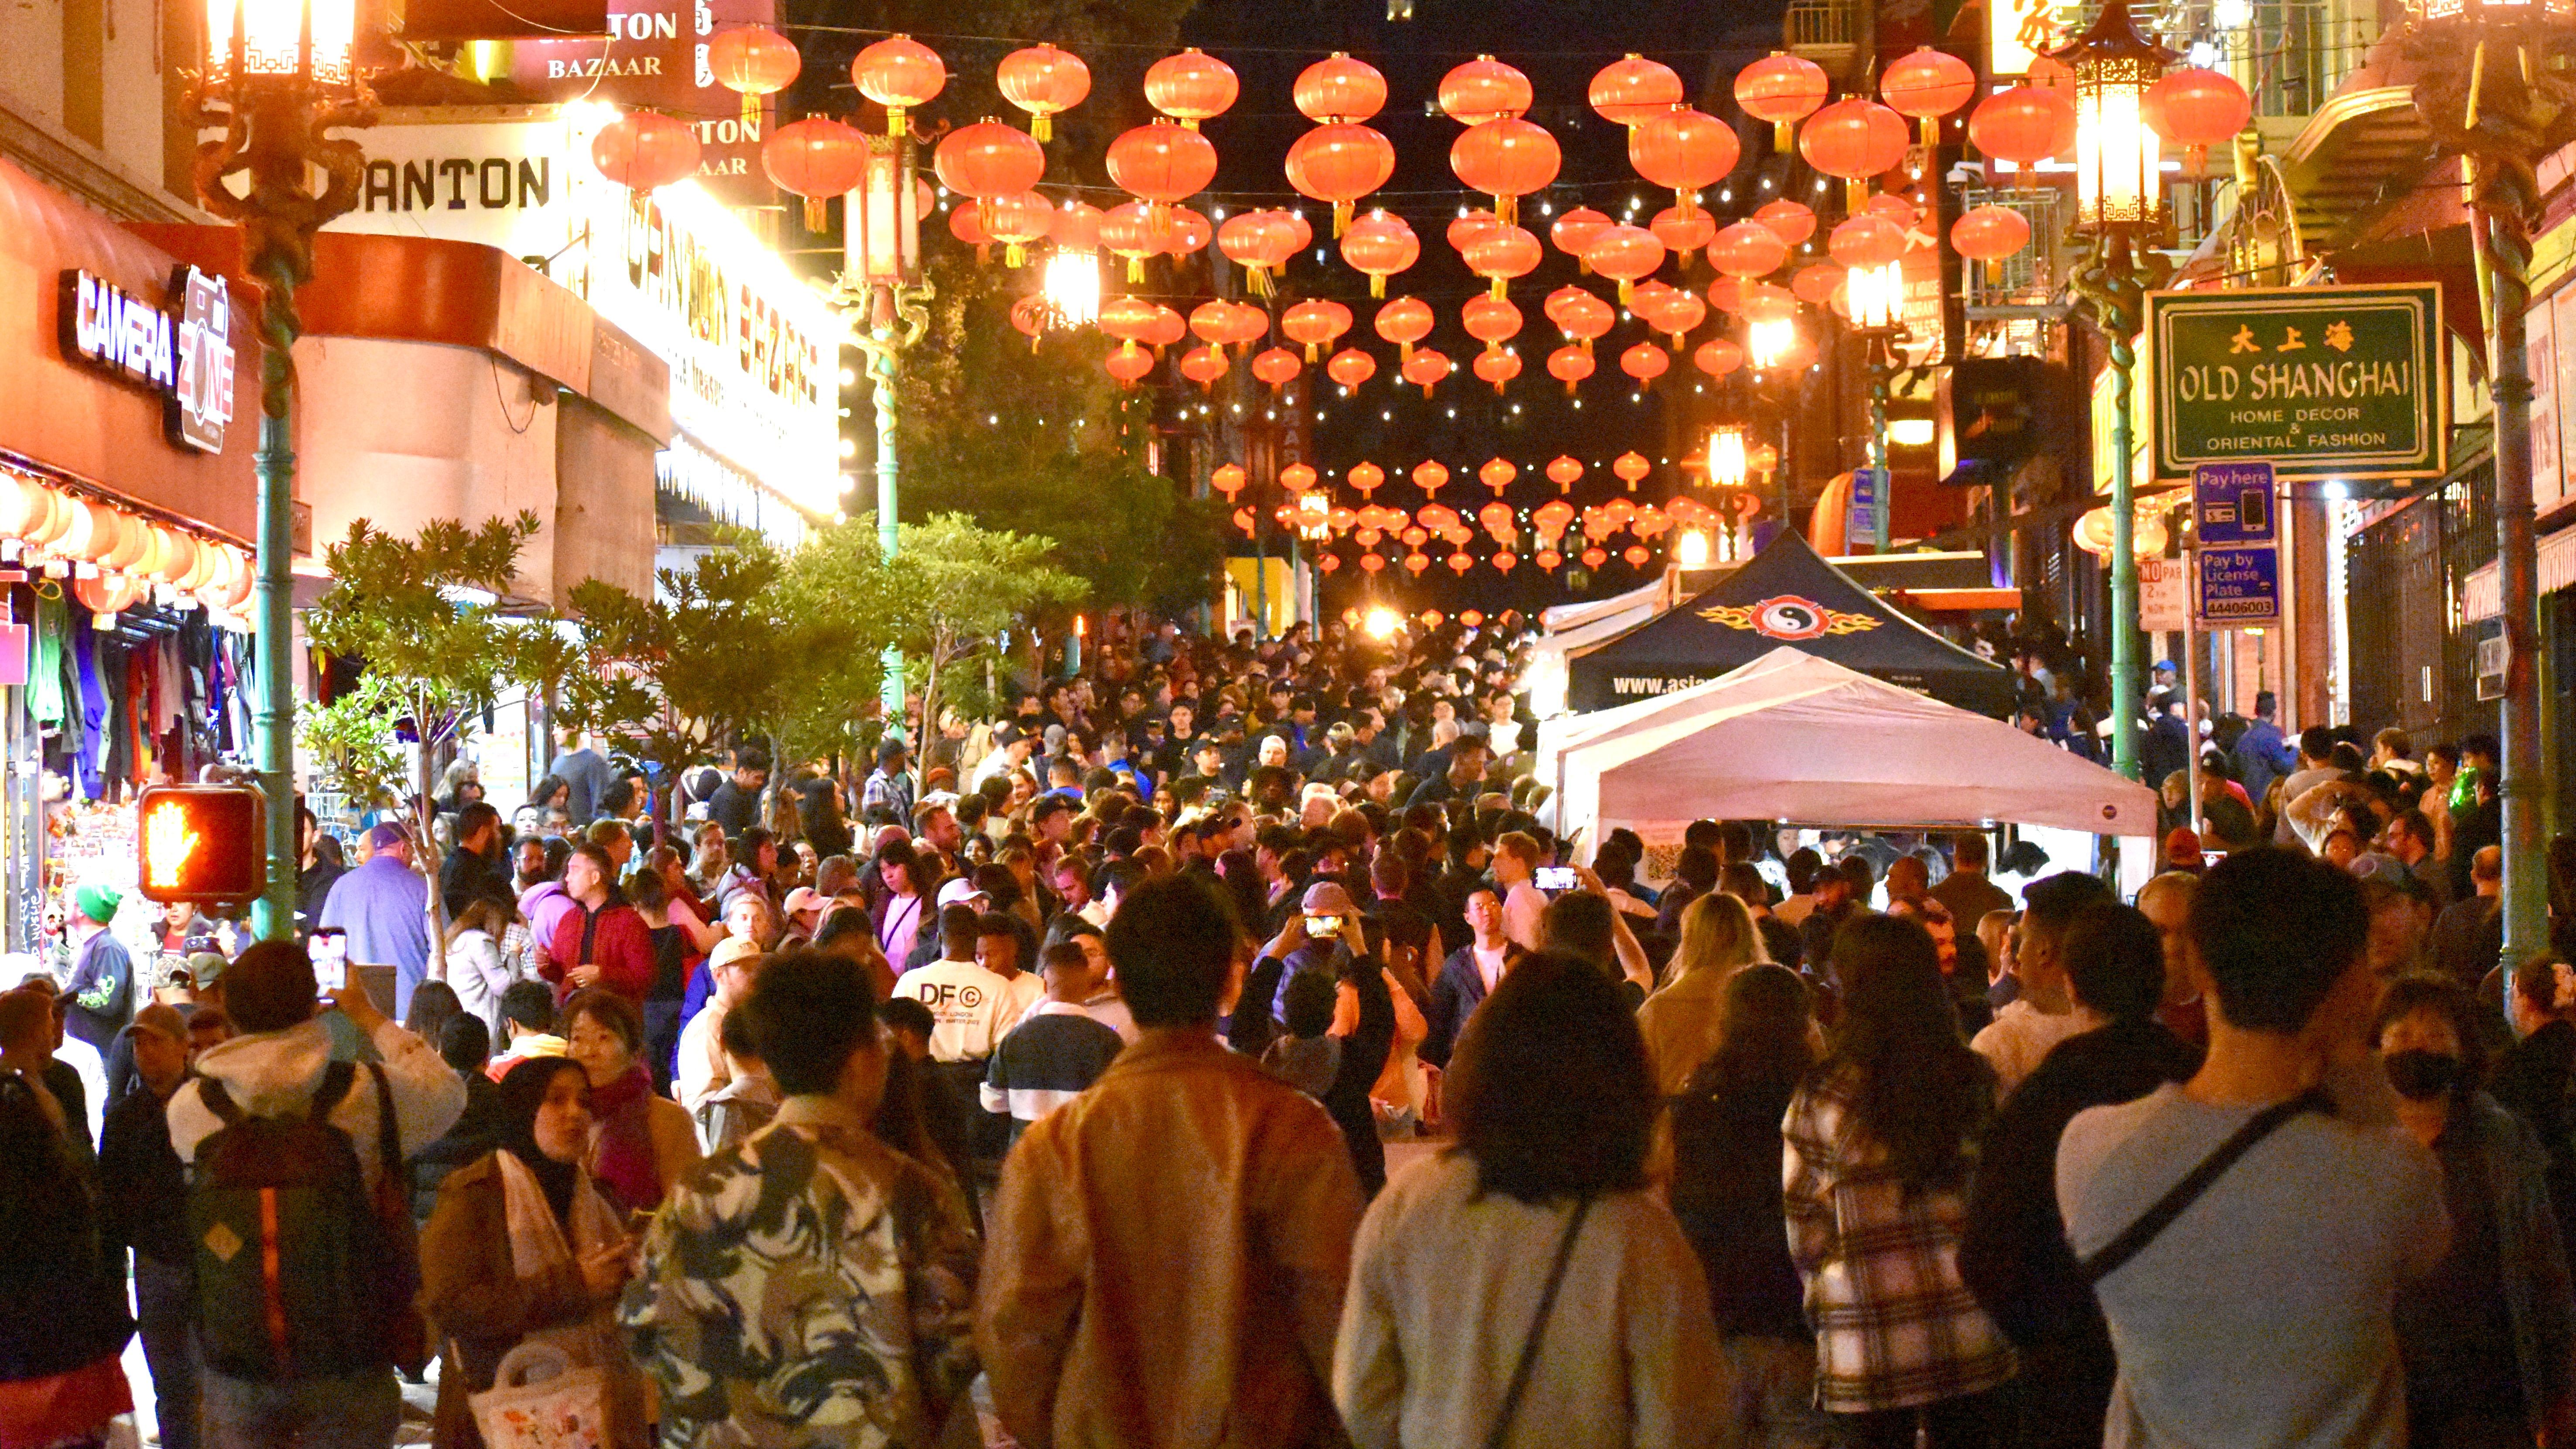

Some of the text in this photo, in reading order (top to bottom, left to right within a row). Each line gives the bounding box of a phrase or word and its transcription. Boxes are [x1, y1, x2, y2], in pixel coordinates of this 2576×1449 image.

[548, 57, 663, 79] BAZAAR
[366, 158, 549, 212] ANTON
[2229, 319, 2354, 354] 大上海
[76, 277, 235, 422] CAMERA ZONE
[2180, 361, 2408, 402] OLD SHANGHAI
[2230, 407, 2360, 424] HOME DECOR
[2290, 422, 2301, 435] &
[2207, 433, 2386, 450] ORIENTAL FASHION
[2200, 470, 2268, 489] Pay here
[2204, 553, 2254, 571] Pay by
[2141, 563, 2160, 581] NO
[2205, 569, 2260, 581] License
[2206, 583, 2243, 597] Plate
[2208, 601, 2271, 614] 44406003
[920, 983, 956, 1006] DF
